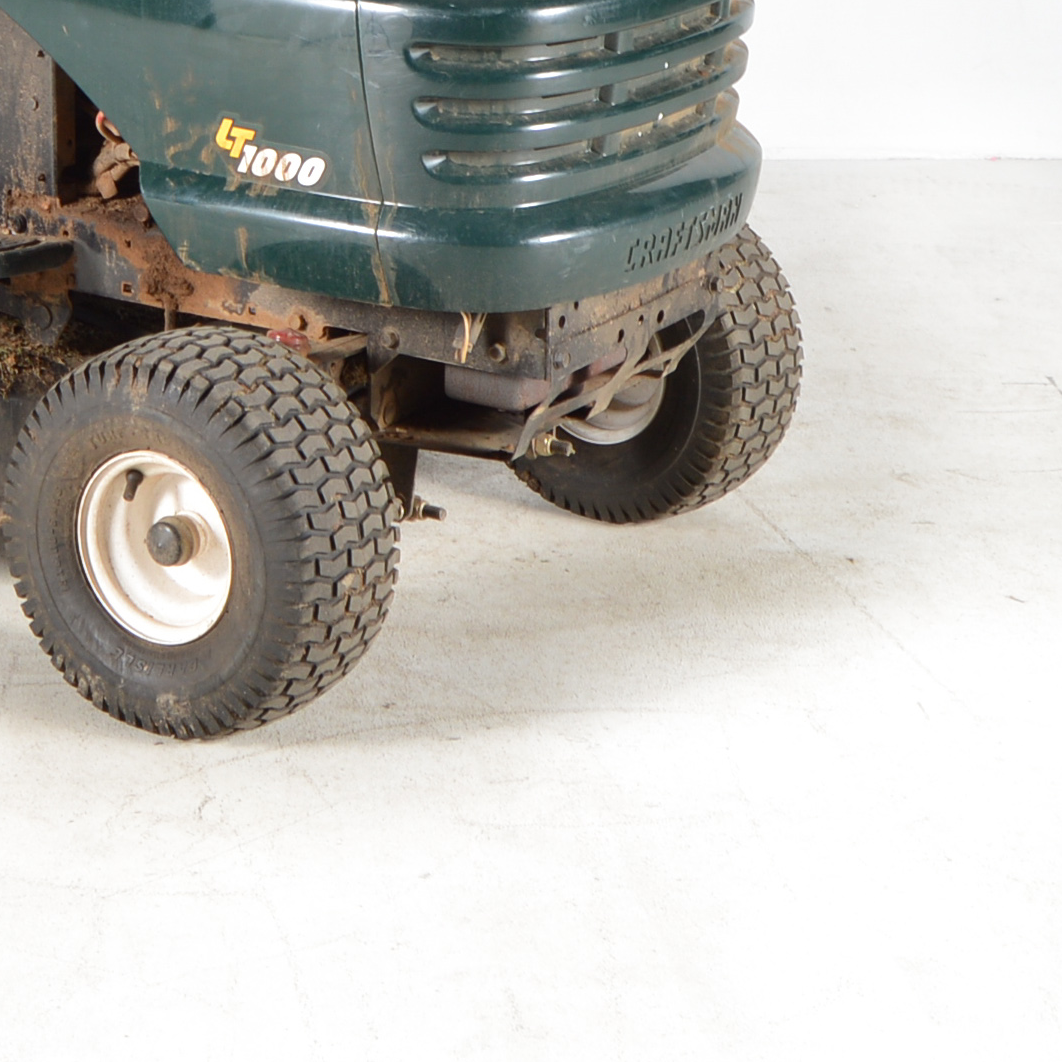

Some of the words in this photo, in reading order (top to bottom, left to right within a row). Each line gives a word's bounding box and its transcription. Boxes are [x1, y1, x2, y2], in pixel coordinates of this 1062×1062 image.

[215, 117, 256, 159] LT
[237, 144, 326, 187] 1000
[624, 192, 743, 273] CRAFTSMAN
